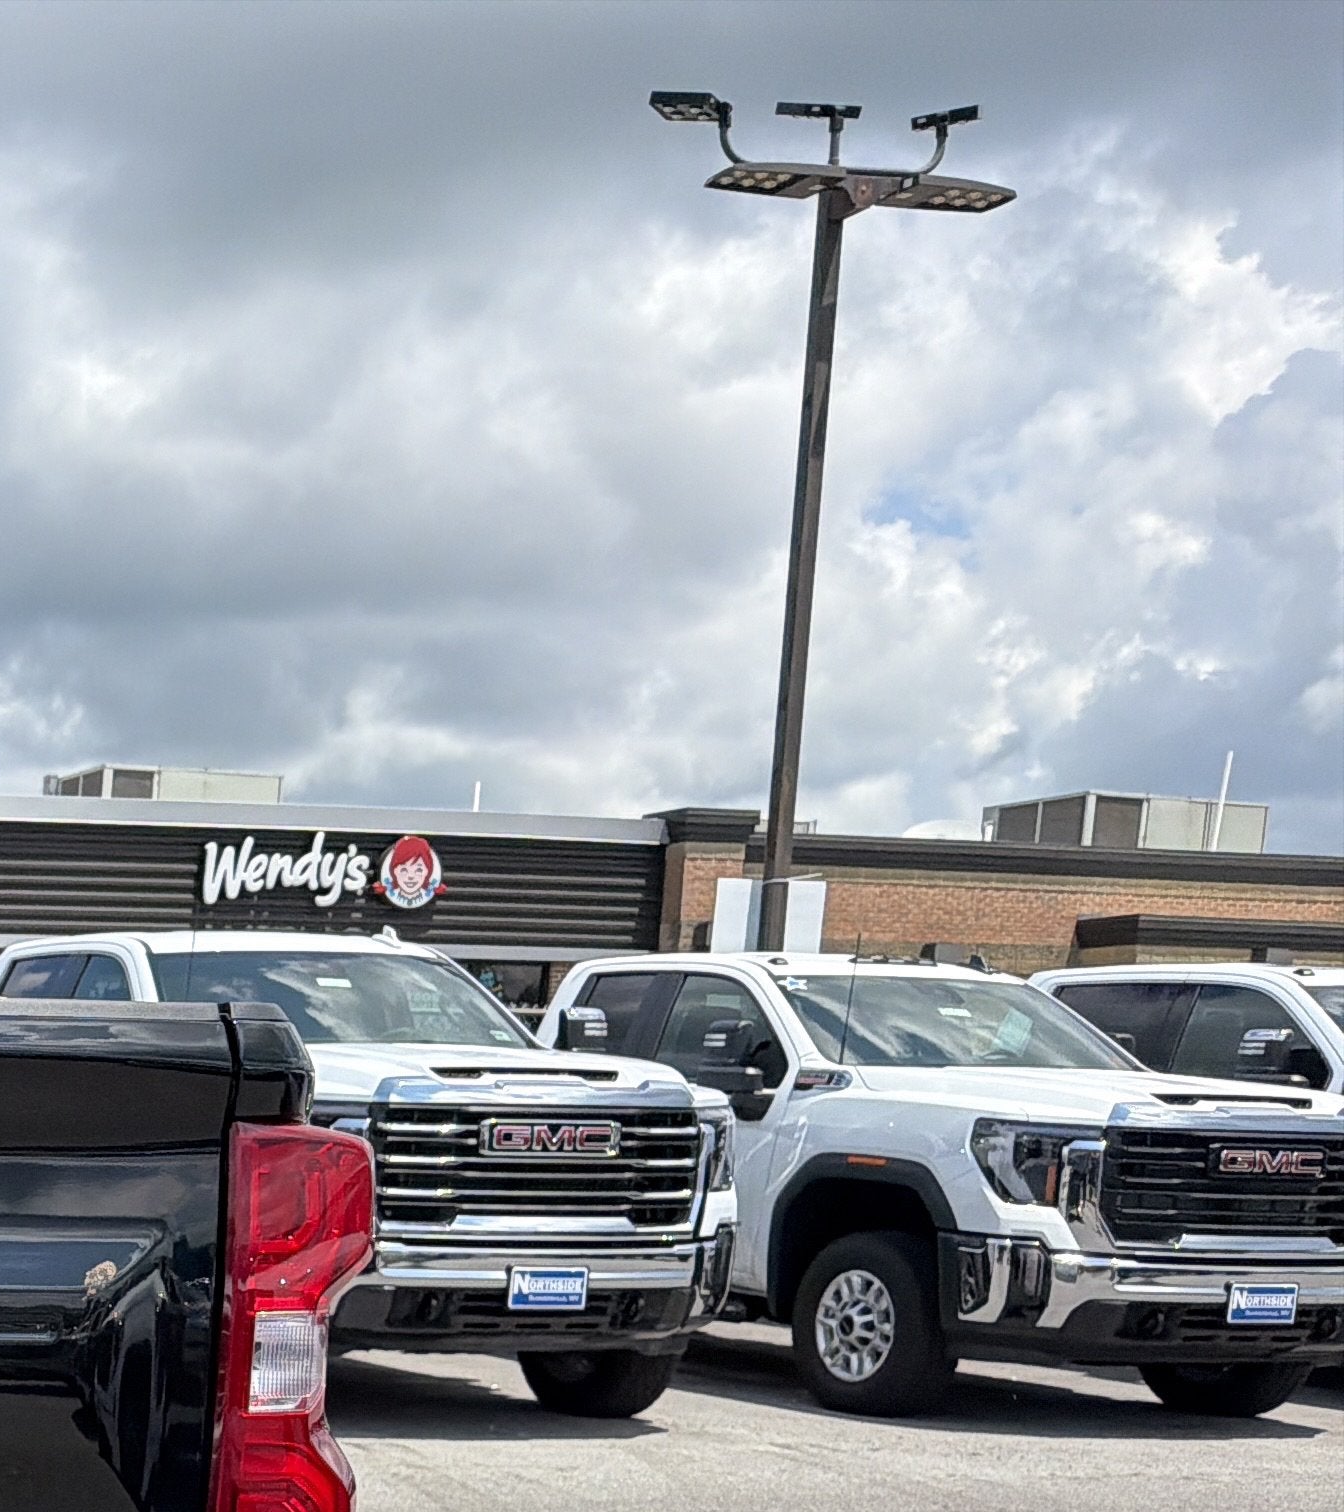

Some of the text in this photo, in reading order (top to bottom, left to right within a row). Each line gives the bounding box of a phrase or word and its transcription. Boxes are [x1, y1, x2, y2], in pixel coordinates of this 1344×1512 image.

[202, 831, 370, 907] Wendy's
[493, 1124, 614, 1151] GMC
[1219, 1149, 1325, 1178] GMC
